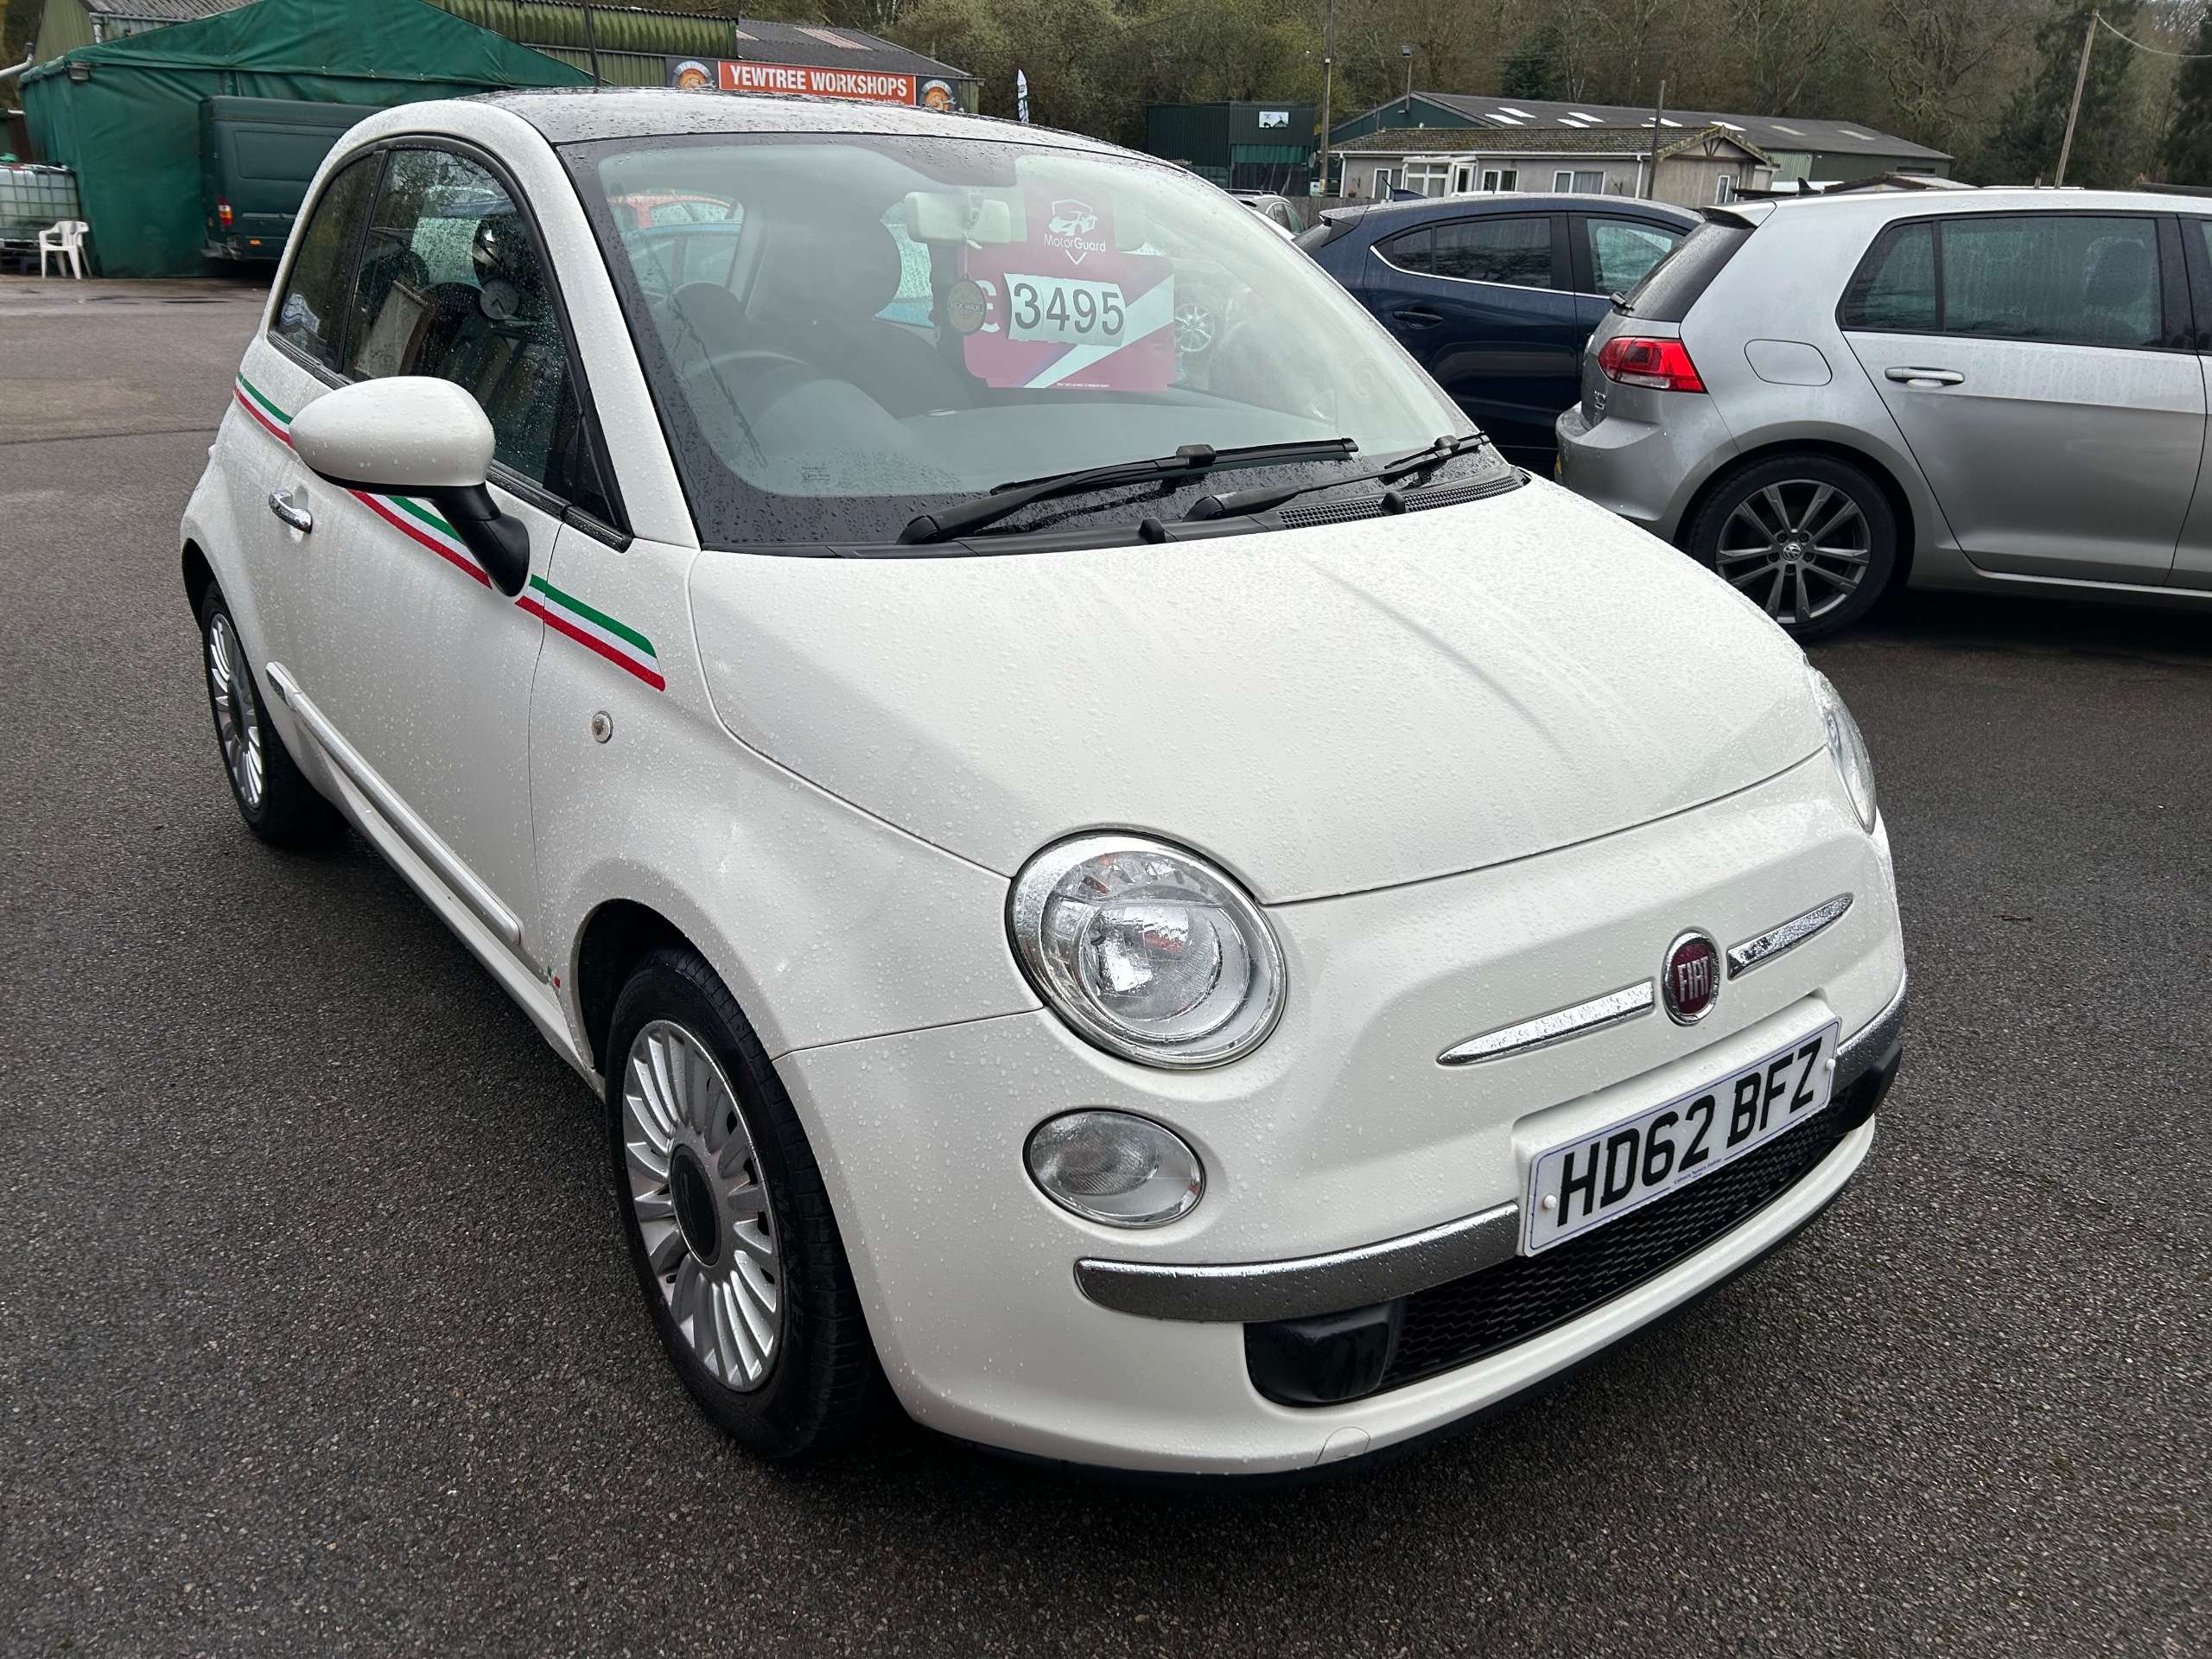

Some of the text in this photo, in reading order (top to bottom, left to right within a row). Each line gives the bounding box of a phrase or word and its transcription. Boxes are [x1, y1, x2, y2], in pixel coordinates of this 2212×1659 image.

[730, 65, 806, 90] YEWTREE
[810, 71, 907, 97] WORKSHOPS
[1044, 232, 1106, 251] MotorGuard
[1014, 283, 1124, 336] 3495
[1677, 956, 1708, 1002] FIAT
[1557, 1036, 1822, 1227] HD62 BFZ
